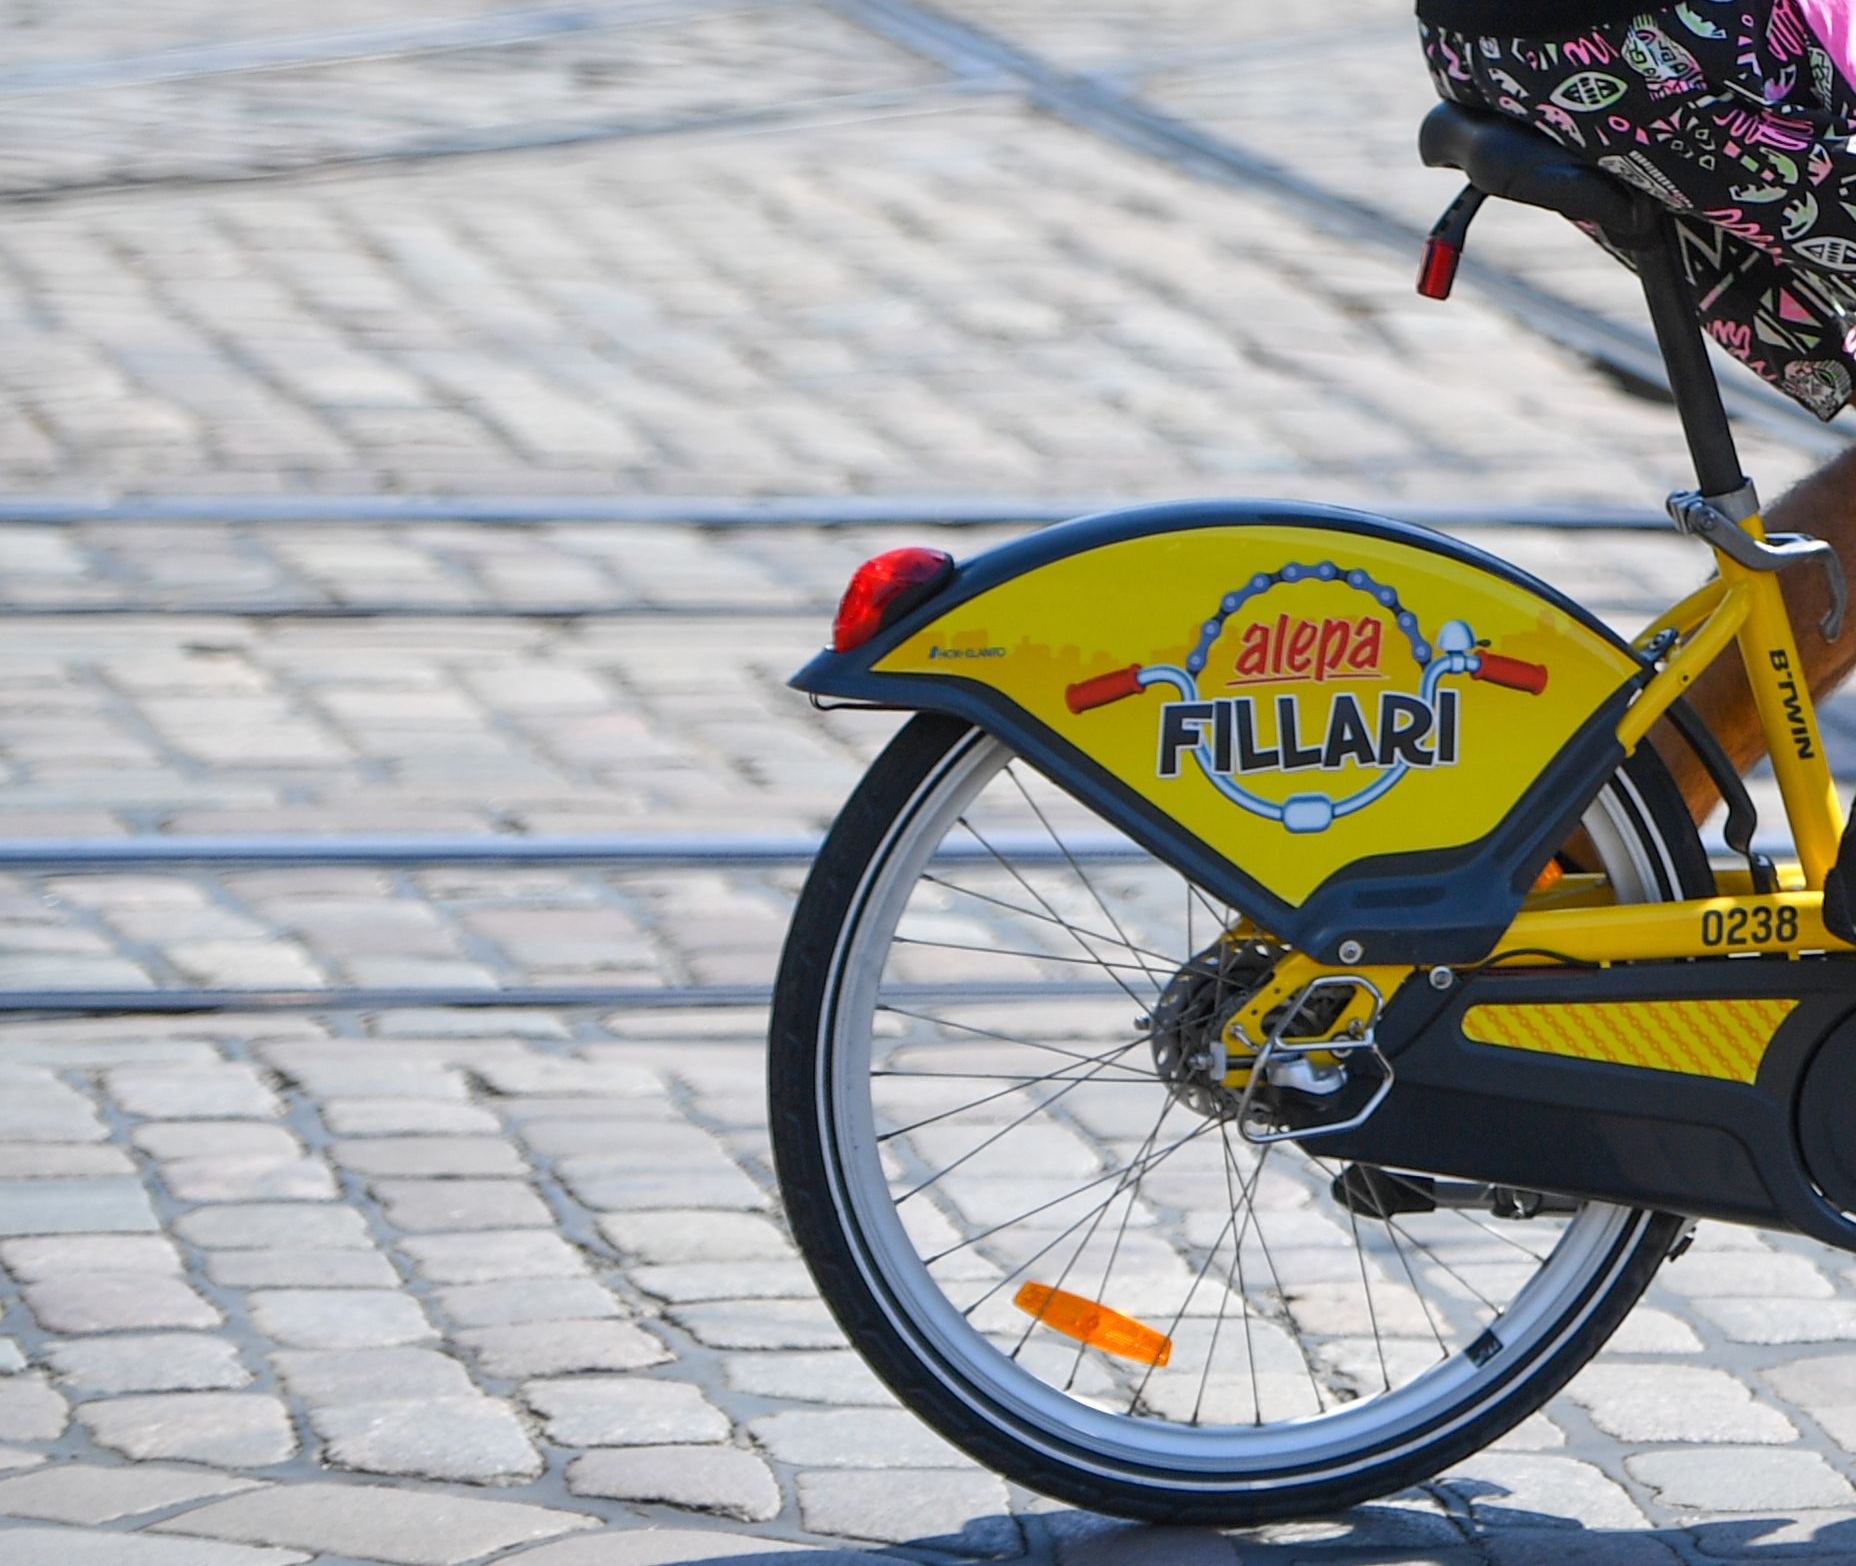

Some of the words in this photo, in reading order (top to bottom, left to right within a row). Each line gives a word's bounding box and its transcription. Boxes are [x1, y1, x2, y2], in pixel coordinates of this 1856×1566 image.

[1233, 612, 1384, 682] alepa
[1157, 689, 1461, 776] FILLARI
[1769, 649, 1815, 759] B'TWIN
[1702, 905, 1798, 946] 0238
